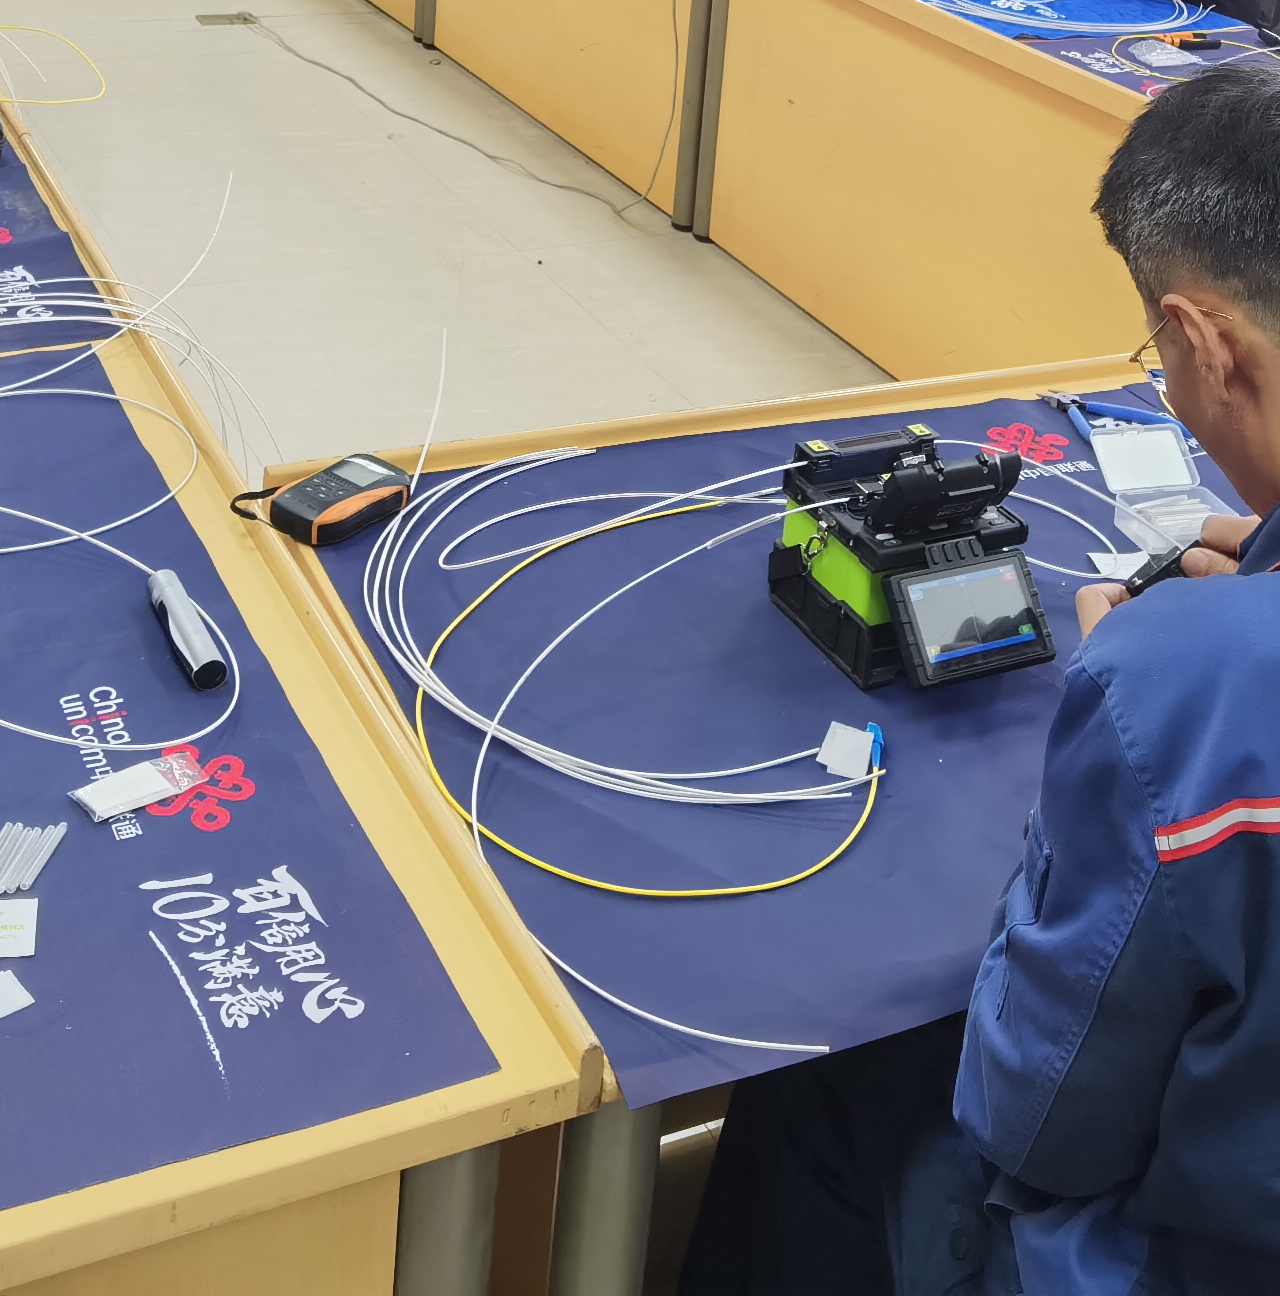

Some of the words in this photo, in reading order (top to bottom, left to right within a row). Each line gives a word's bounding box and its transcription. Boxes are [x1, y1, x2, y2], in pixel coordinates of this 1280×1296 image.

[88, 685, 133, 746] China
[138, 872, 285, 1029] 10分满意
[232, 865, 365, 1024] 百倍用心
